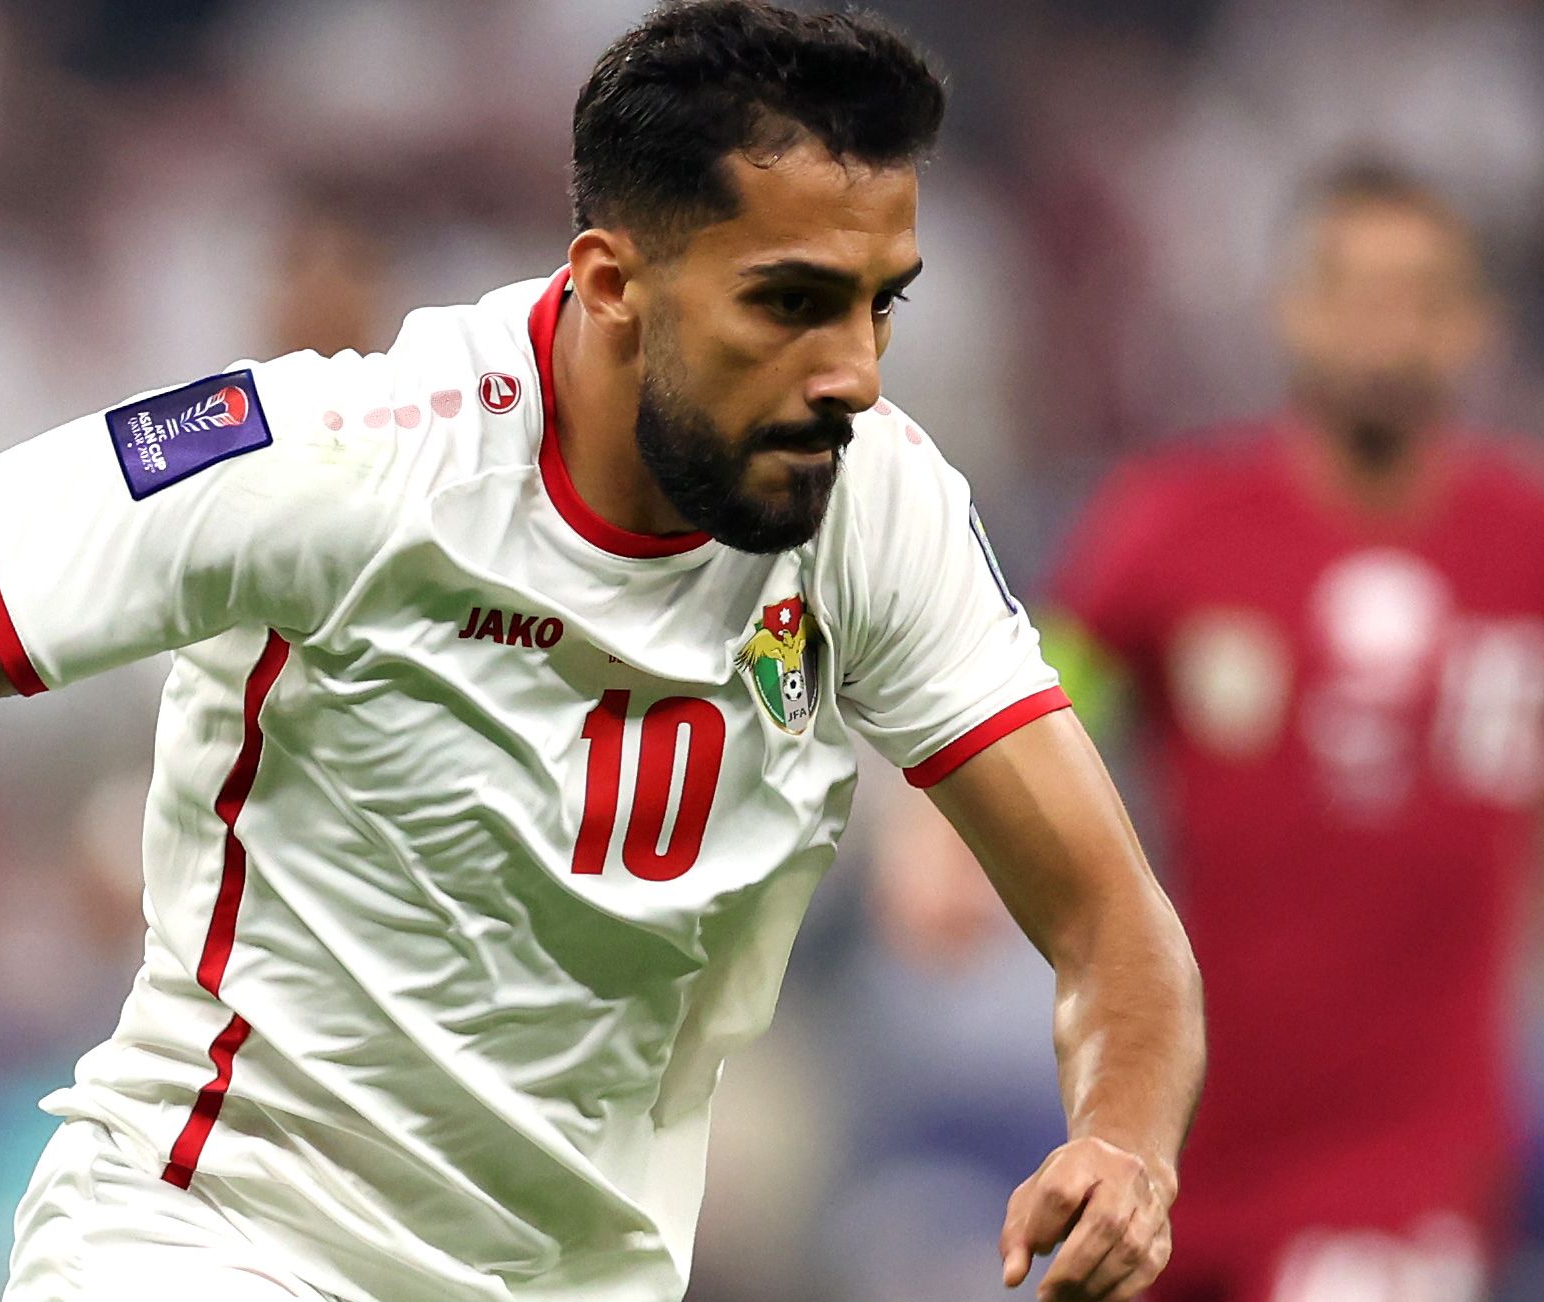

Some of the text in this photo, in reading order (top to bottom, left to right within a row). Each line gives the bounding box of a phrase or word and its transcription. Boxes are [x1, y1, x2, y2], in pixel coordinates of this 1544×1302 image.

[128, 416, 144, 446] QATAR
[138, 411, 166, 471] ASIAN CUP
[154, 424, 167, 442] AFC
[458, 606, 564, 649] JAKO
[788, 708, 807, 722] JFA
[571, 689, 726, 881] 10
